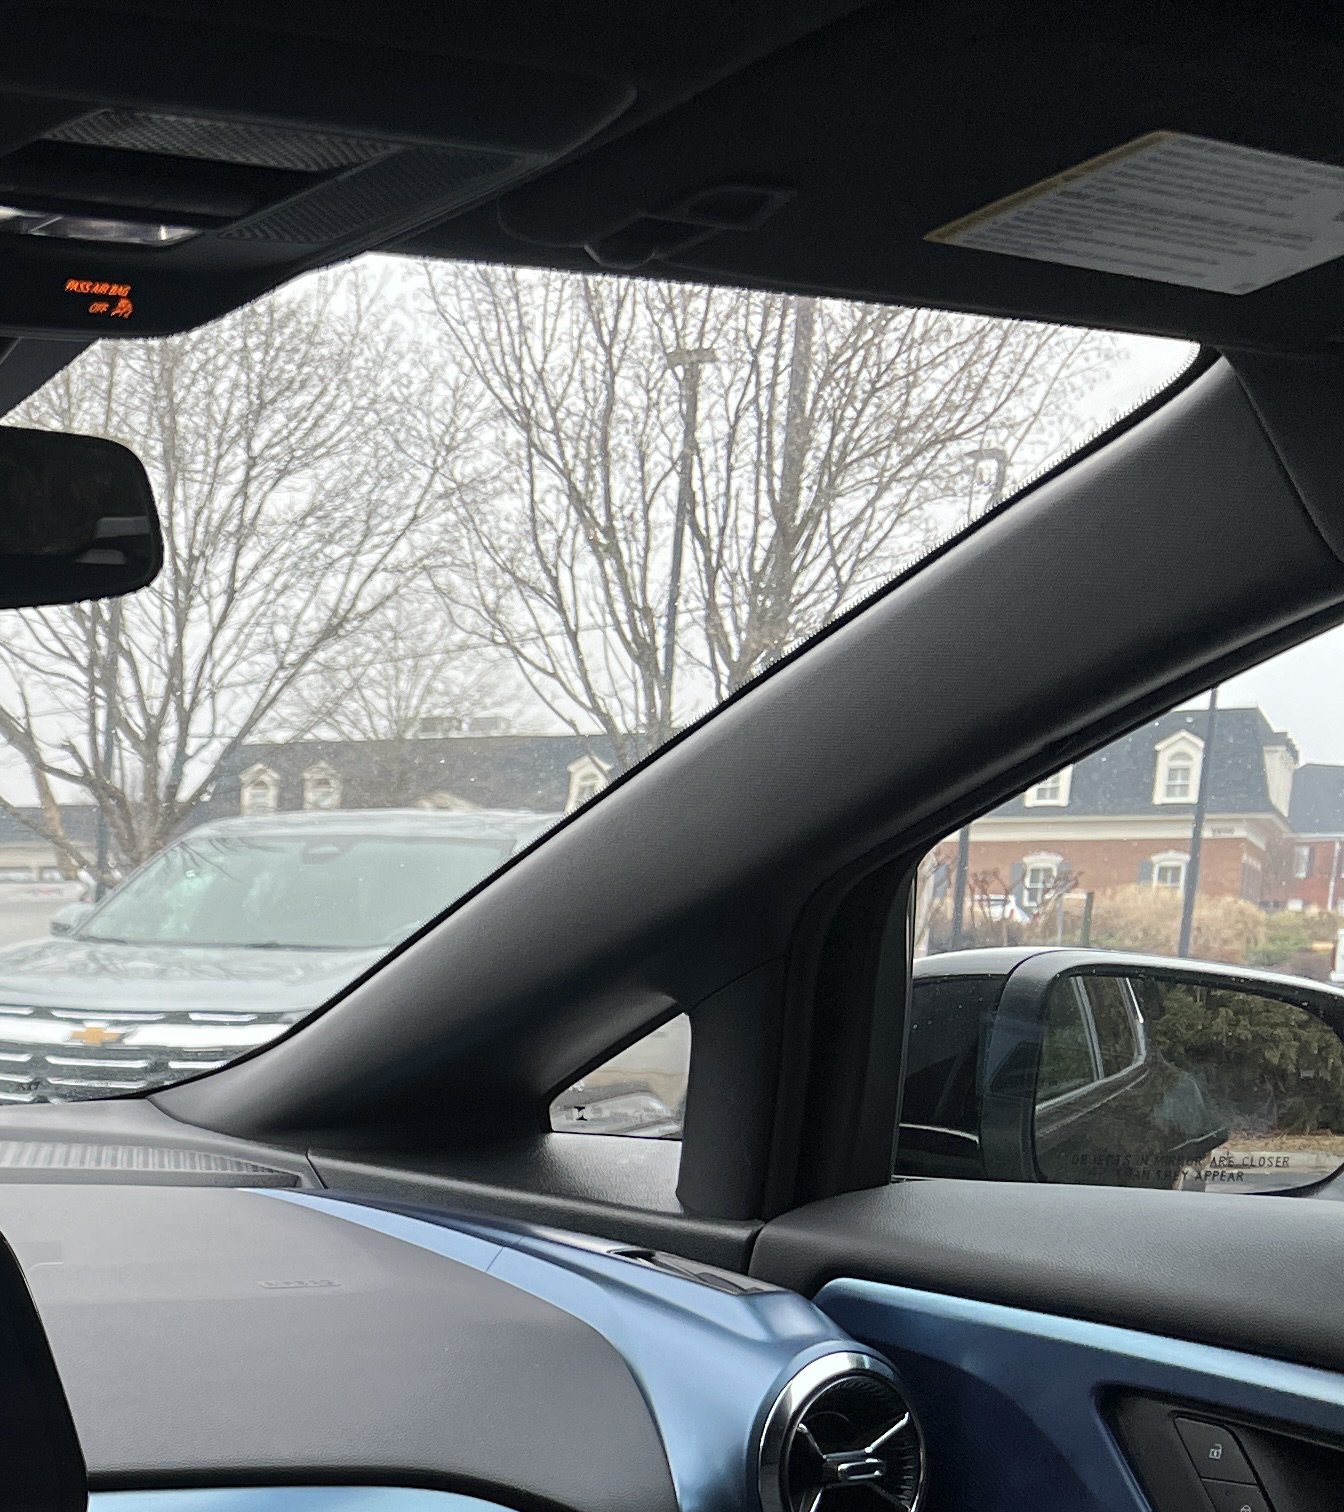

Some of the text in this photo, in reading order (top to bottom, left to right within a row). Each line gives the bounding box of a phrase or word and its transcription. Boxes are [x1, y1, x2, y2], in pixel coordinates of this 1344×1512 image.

[65, 280, 131, 297] PASS AIR BAG
[89, 302, 110, 313] OFF
[1210, 1156, 1235, 1168] ARE
[1242, 1156, 1290, 1168] CLOSER
[1194, 1170, 1244, 1182] APPEAR
